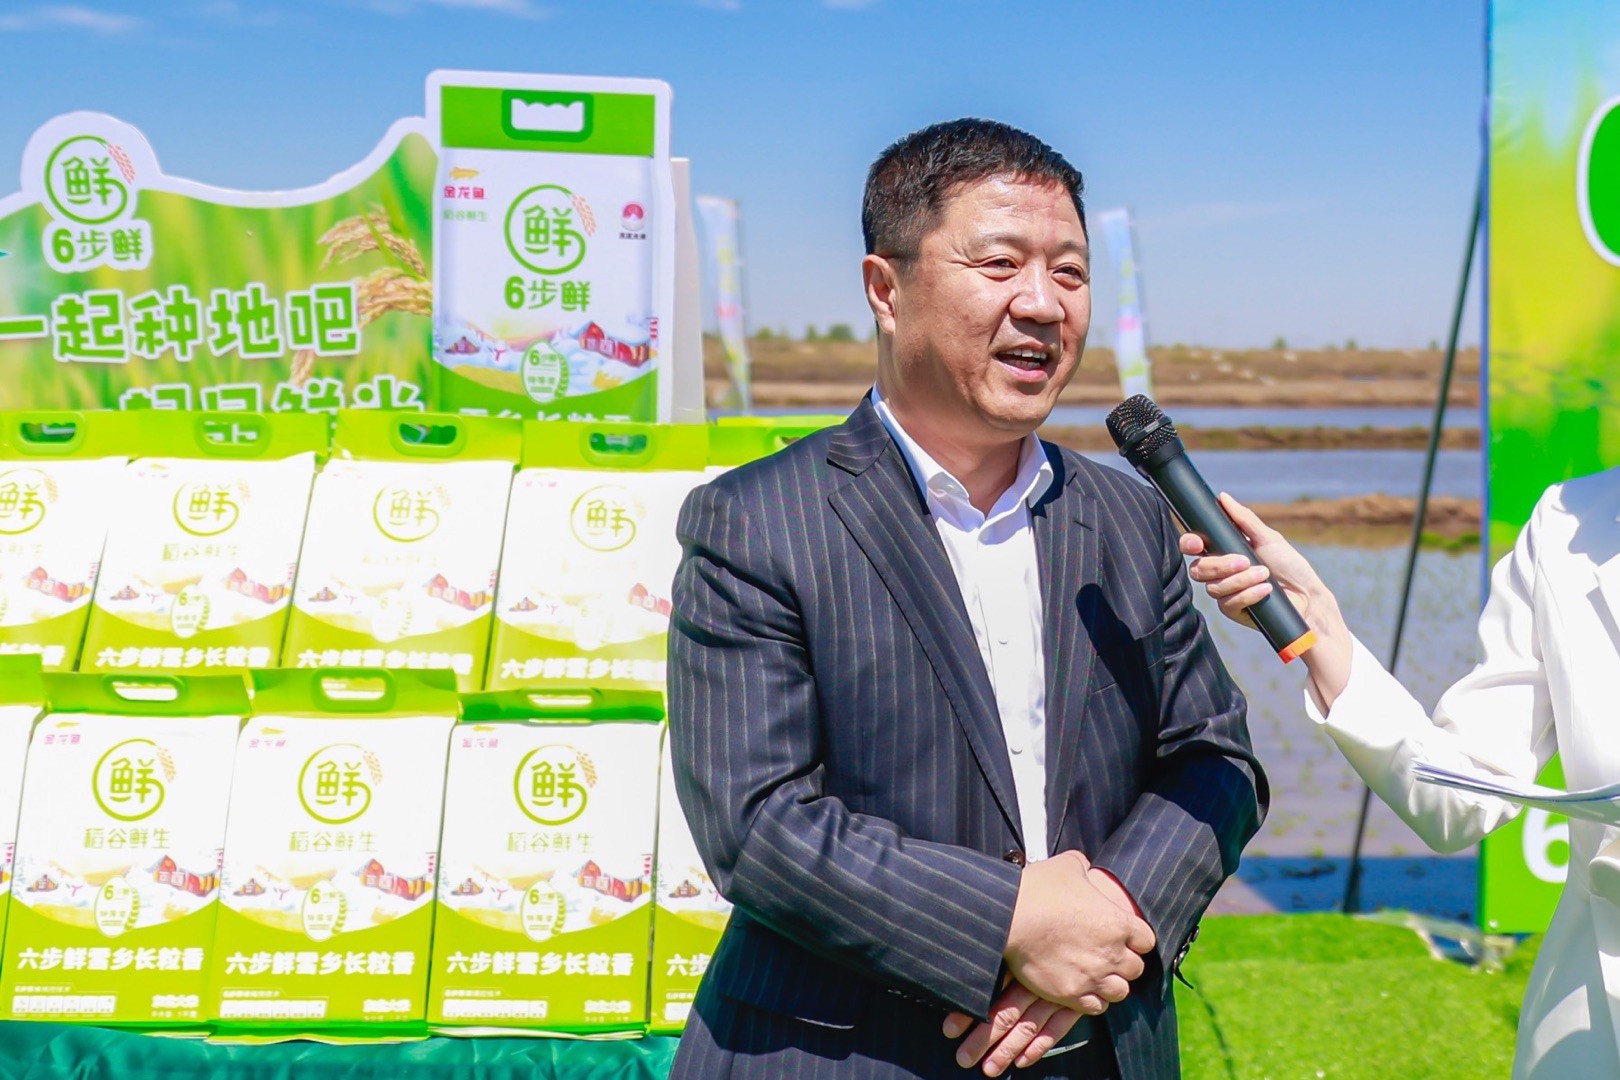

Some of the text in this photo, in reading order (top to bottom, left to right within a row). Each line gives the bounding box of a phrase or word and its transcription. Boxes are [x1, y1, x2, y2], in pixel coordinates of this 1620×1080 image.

[52, 228, 144, 264] 6步鲜
[504, 275, 591, 312] 6步鲜
[0, 284, 358, 360] 一起种地吧
